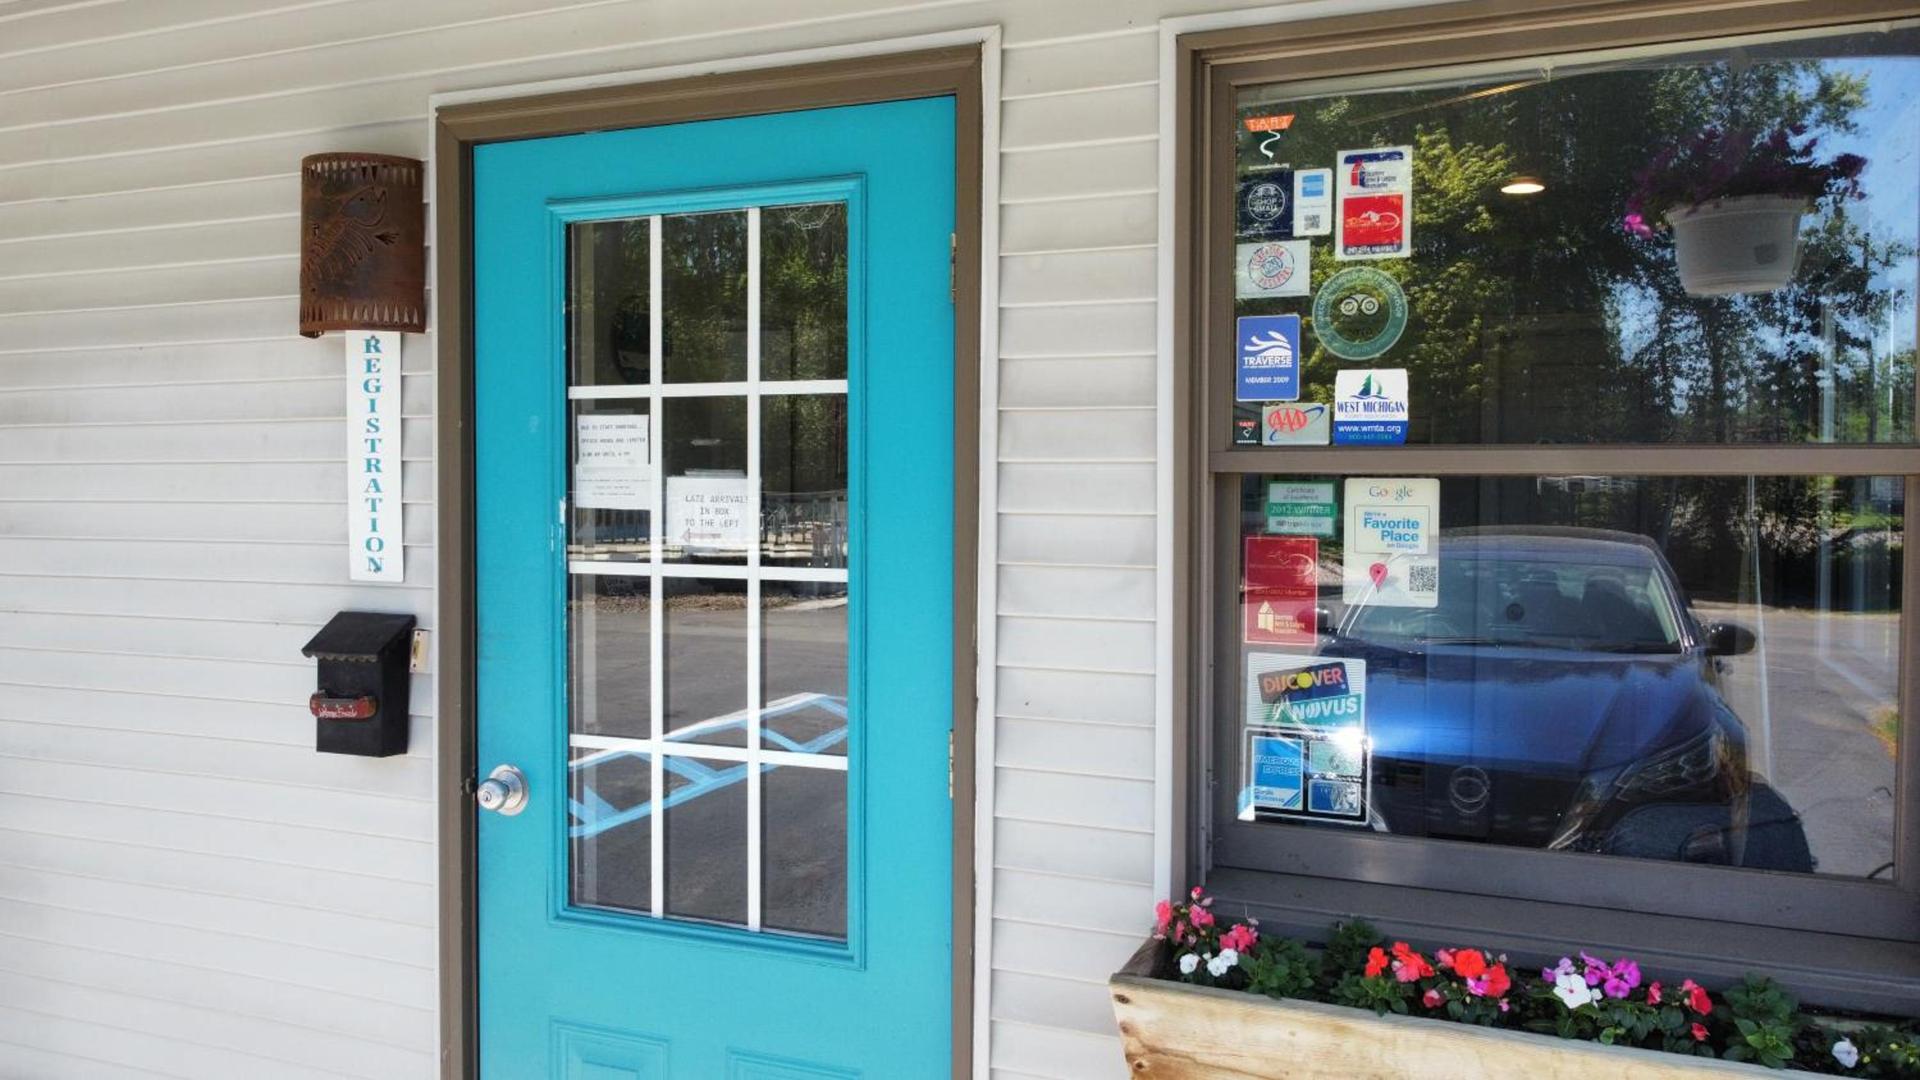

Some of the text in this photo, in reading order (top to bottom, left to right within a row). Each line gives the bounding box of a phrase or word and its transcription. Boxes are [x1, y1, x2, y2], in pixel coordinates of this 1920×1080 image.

[1242, 356, 1293, 366] TRAVERSE
[1337, 401, 1405, 412] WEST MICHIGAN
[1270, 407, 1307, 431] AAA
[1337, 425, 1401, 435] www.wmta.org
[363, 337, 384, 573] REGISTRATION
[685, 494, 705, 503] LATE
[1369, 485, 1413, 501] Google
[700, 506, 729, 515] IN BOX
[685, 518, 739, 528] TO THE LEFT
[1363, 516, 1420, 529] Favorite
[1381, 530, 1419, 542] Place
[1263, 667, 1343, 693] DISCOVER
[1291, 697, 1358, 720] NOVUS
